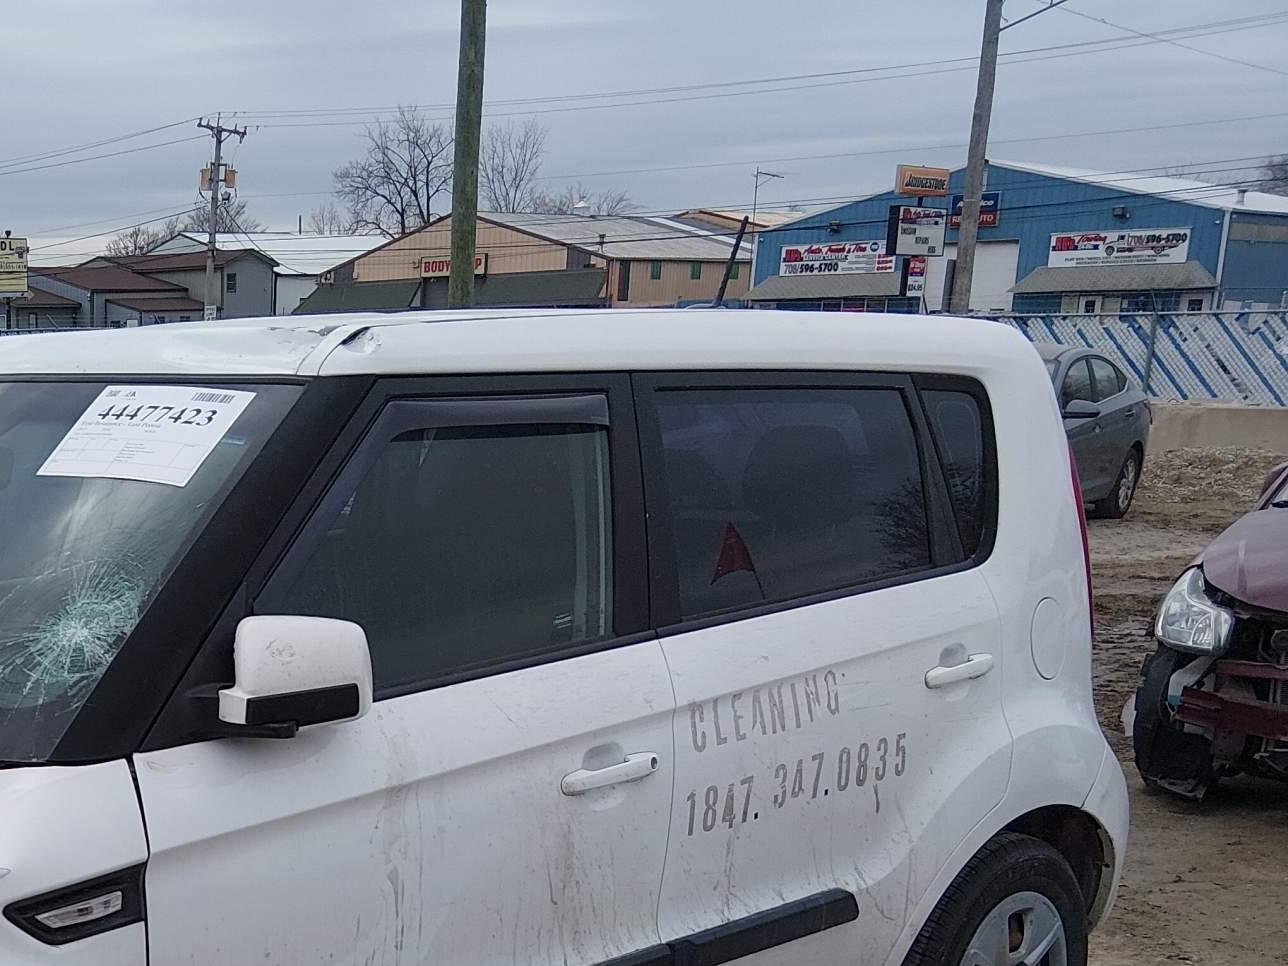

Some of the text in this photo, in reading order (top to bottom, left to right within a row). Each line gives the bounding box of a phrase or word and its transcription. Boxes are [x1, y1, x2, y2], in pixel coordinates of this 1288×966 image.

[424, 260, 450, 273] BODY
[98, 404, 218, 426] 44477423
[688, 669, 841, 753] CLEANING
